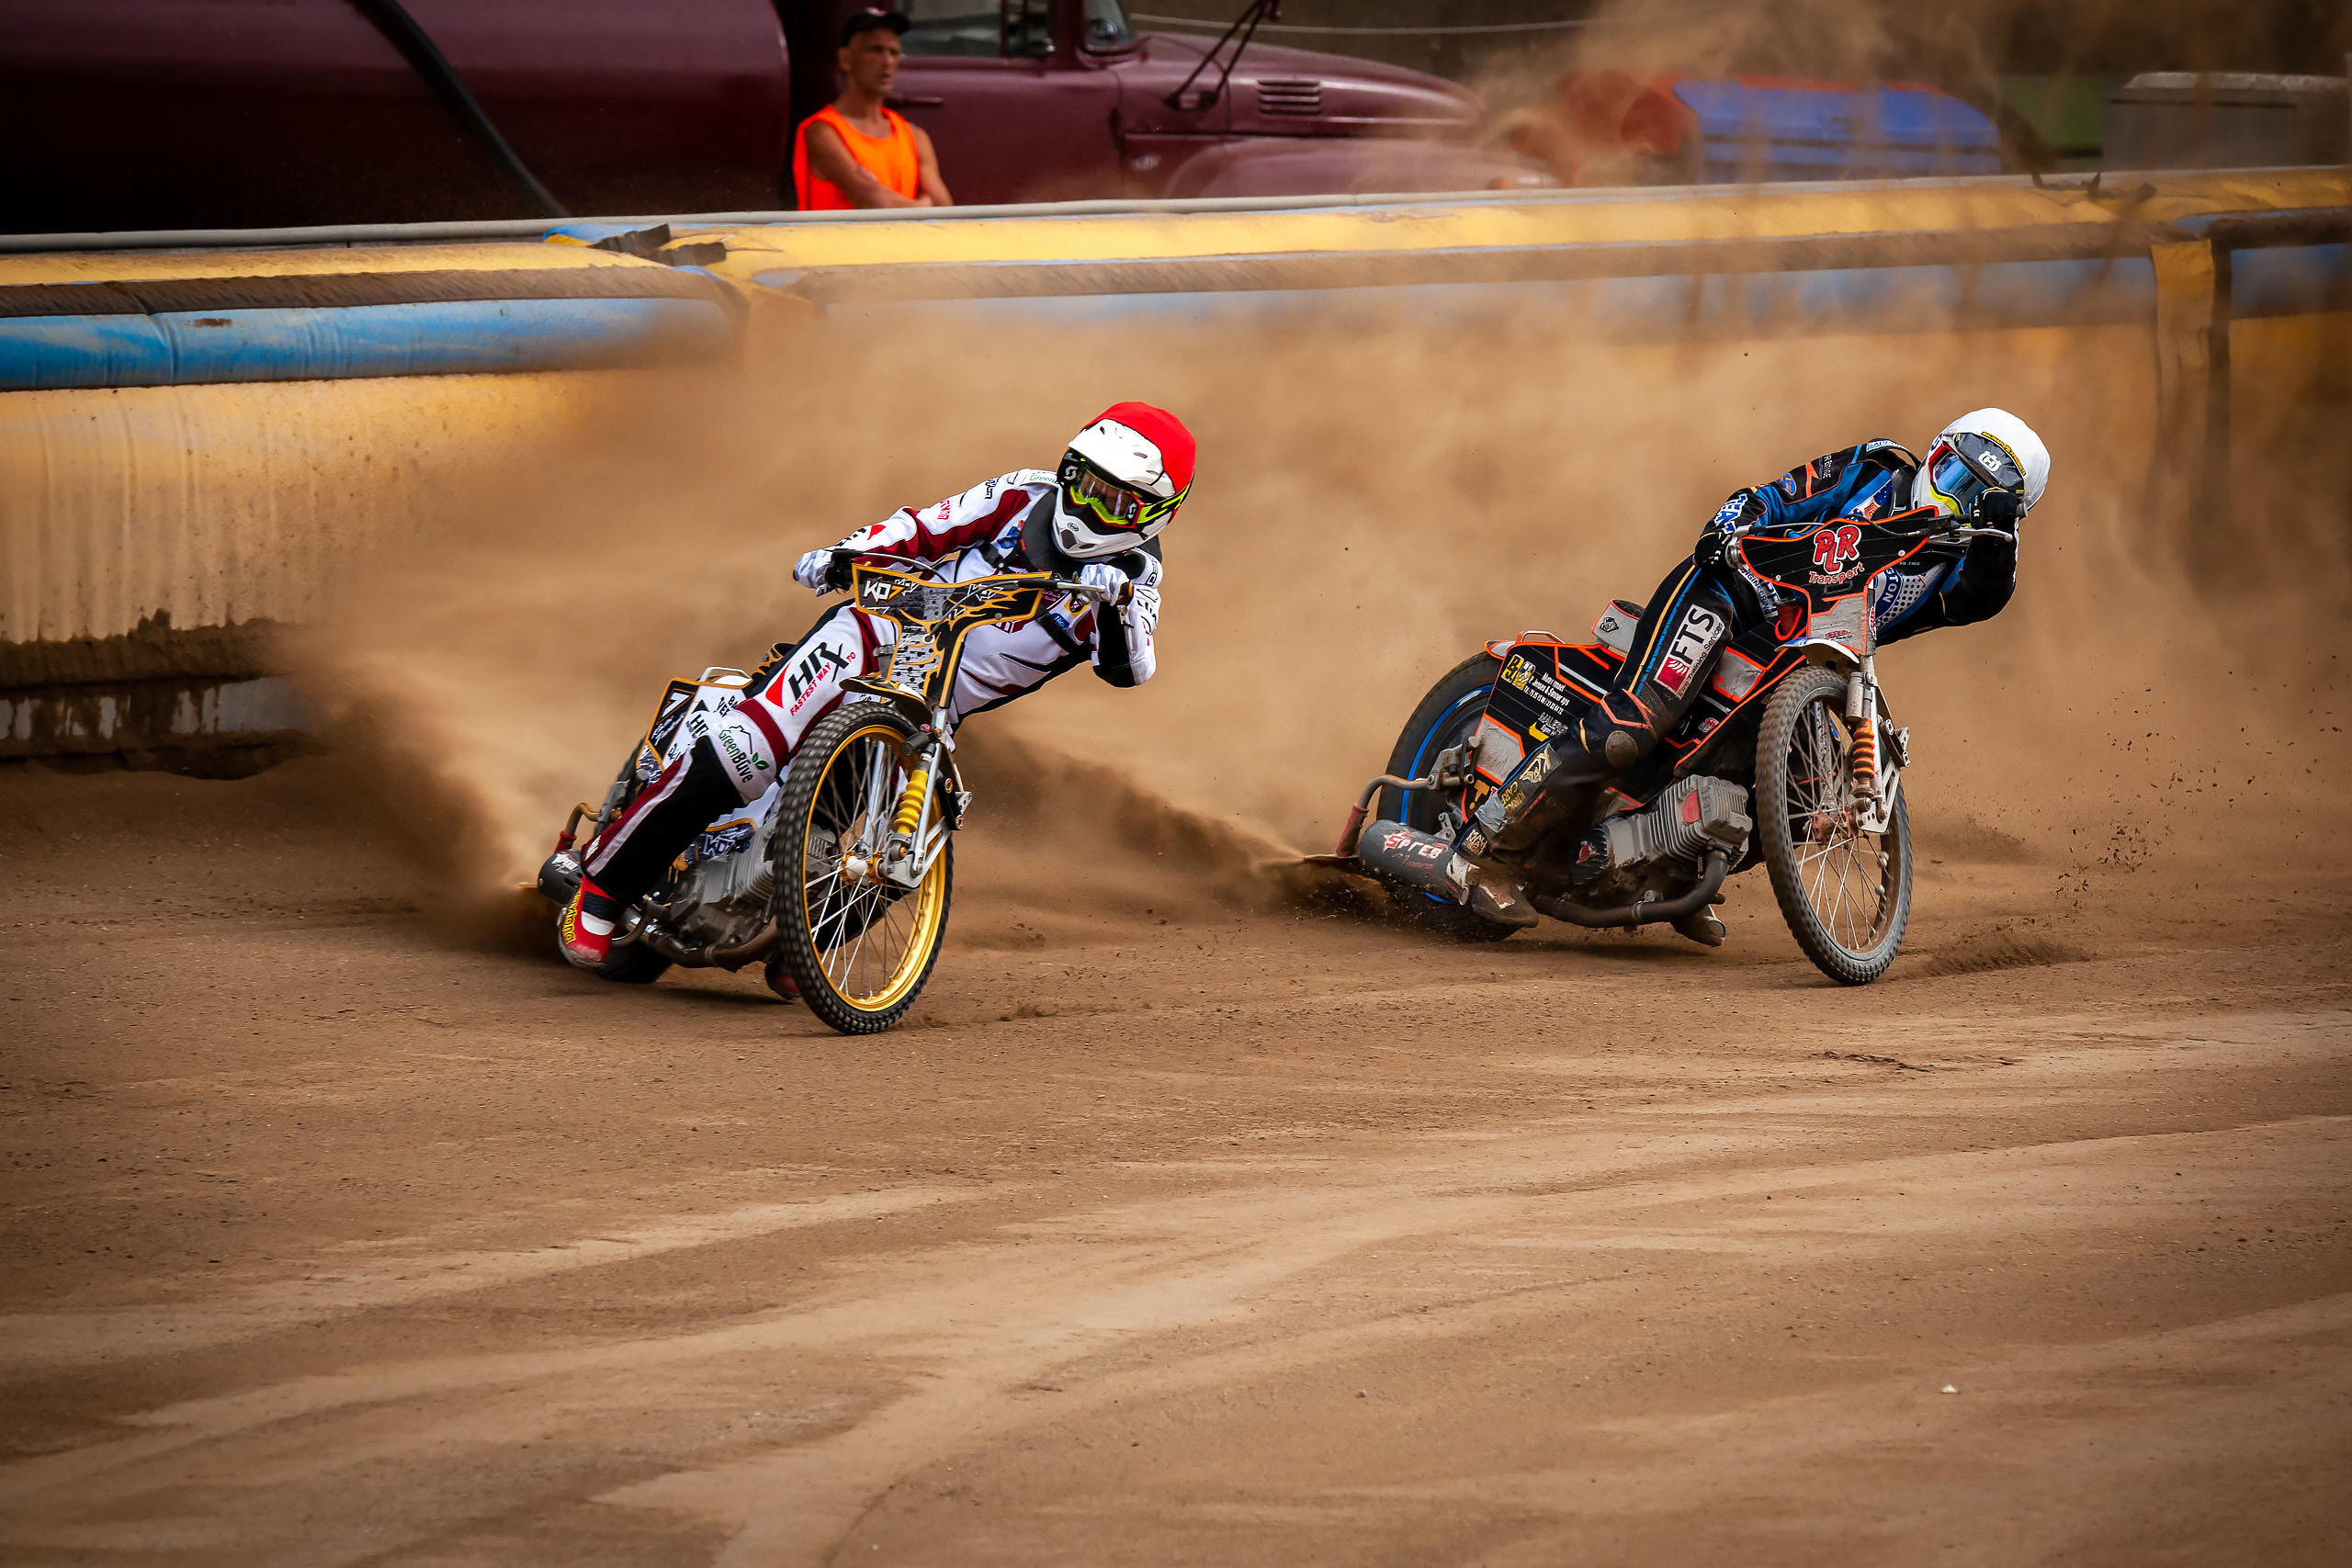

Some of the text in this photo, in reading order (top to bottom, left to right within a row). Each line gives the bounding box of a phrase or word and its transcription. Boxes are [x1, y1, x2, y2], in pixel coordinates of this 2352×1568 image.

[1809, 562, 1865, 584] Transport
[1813, 525, 1862, 574] PLR
[1670, 607, 1714, 665] FTS
[1688, 650, 1707, 680] Training
[1703, 622, 1724, 650] Services
[790, 651, 856, 716] FASTEST WAY TO
